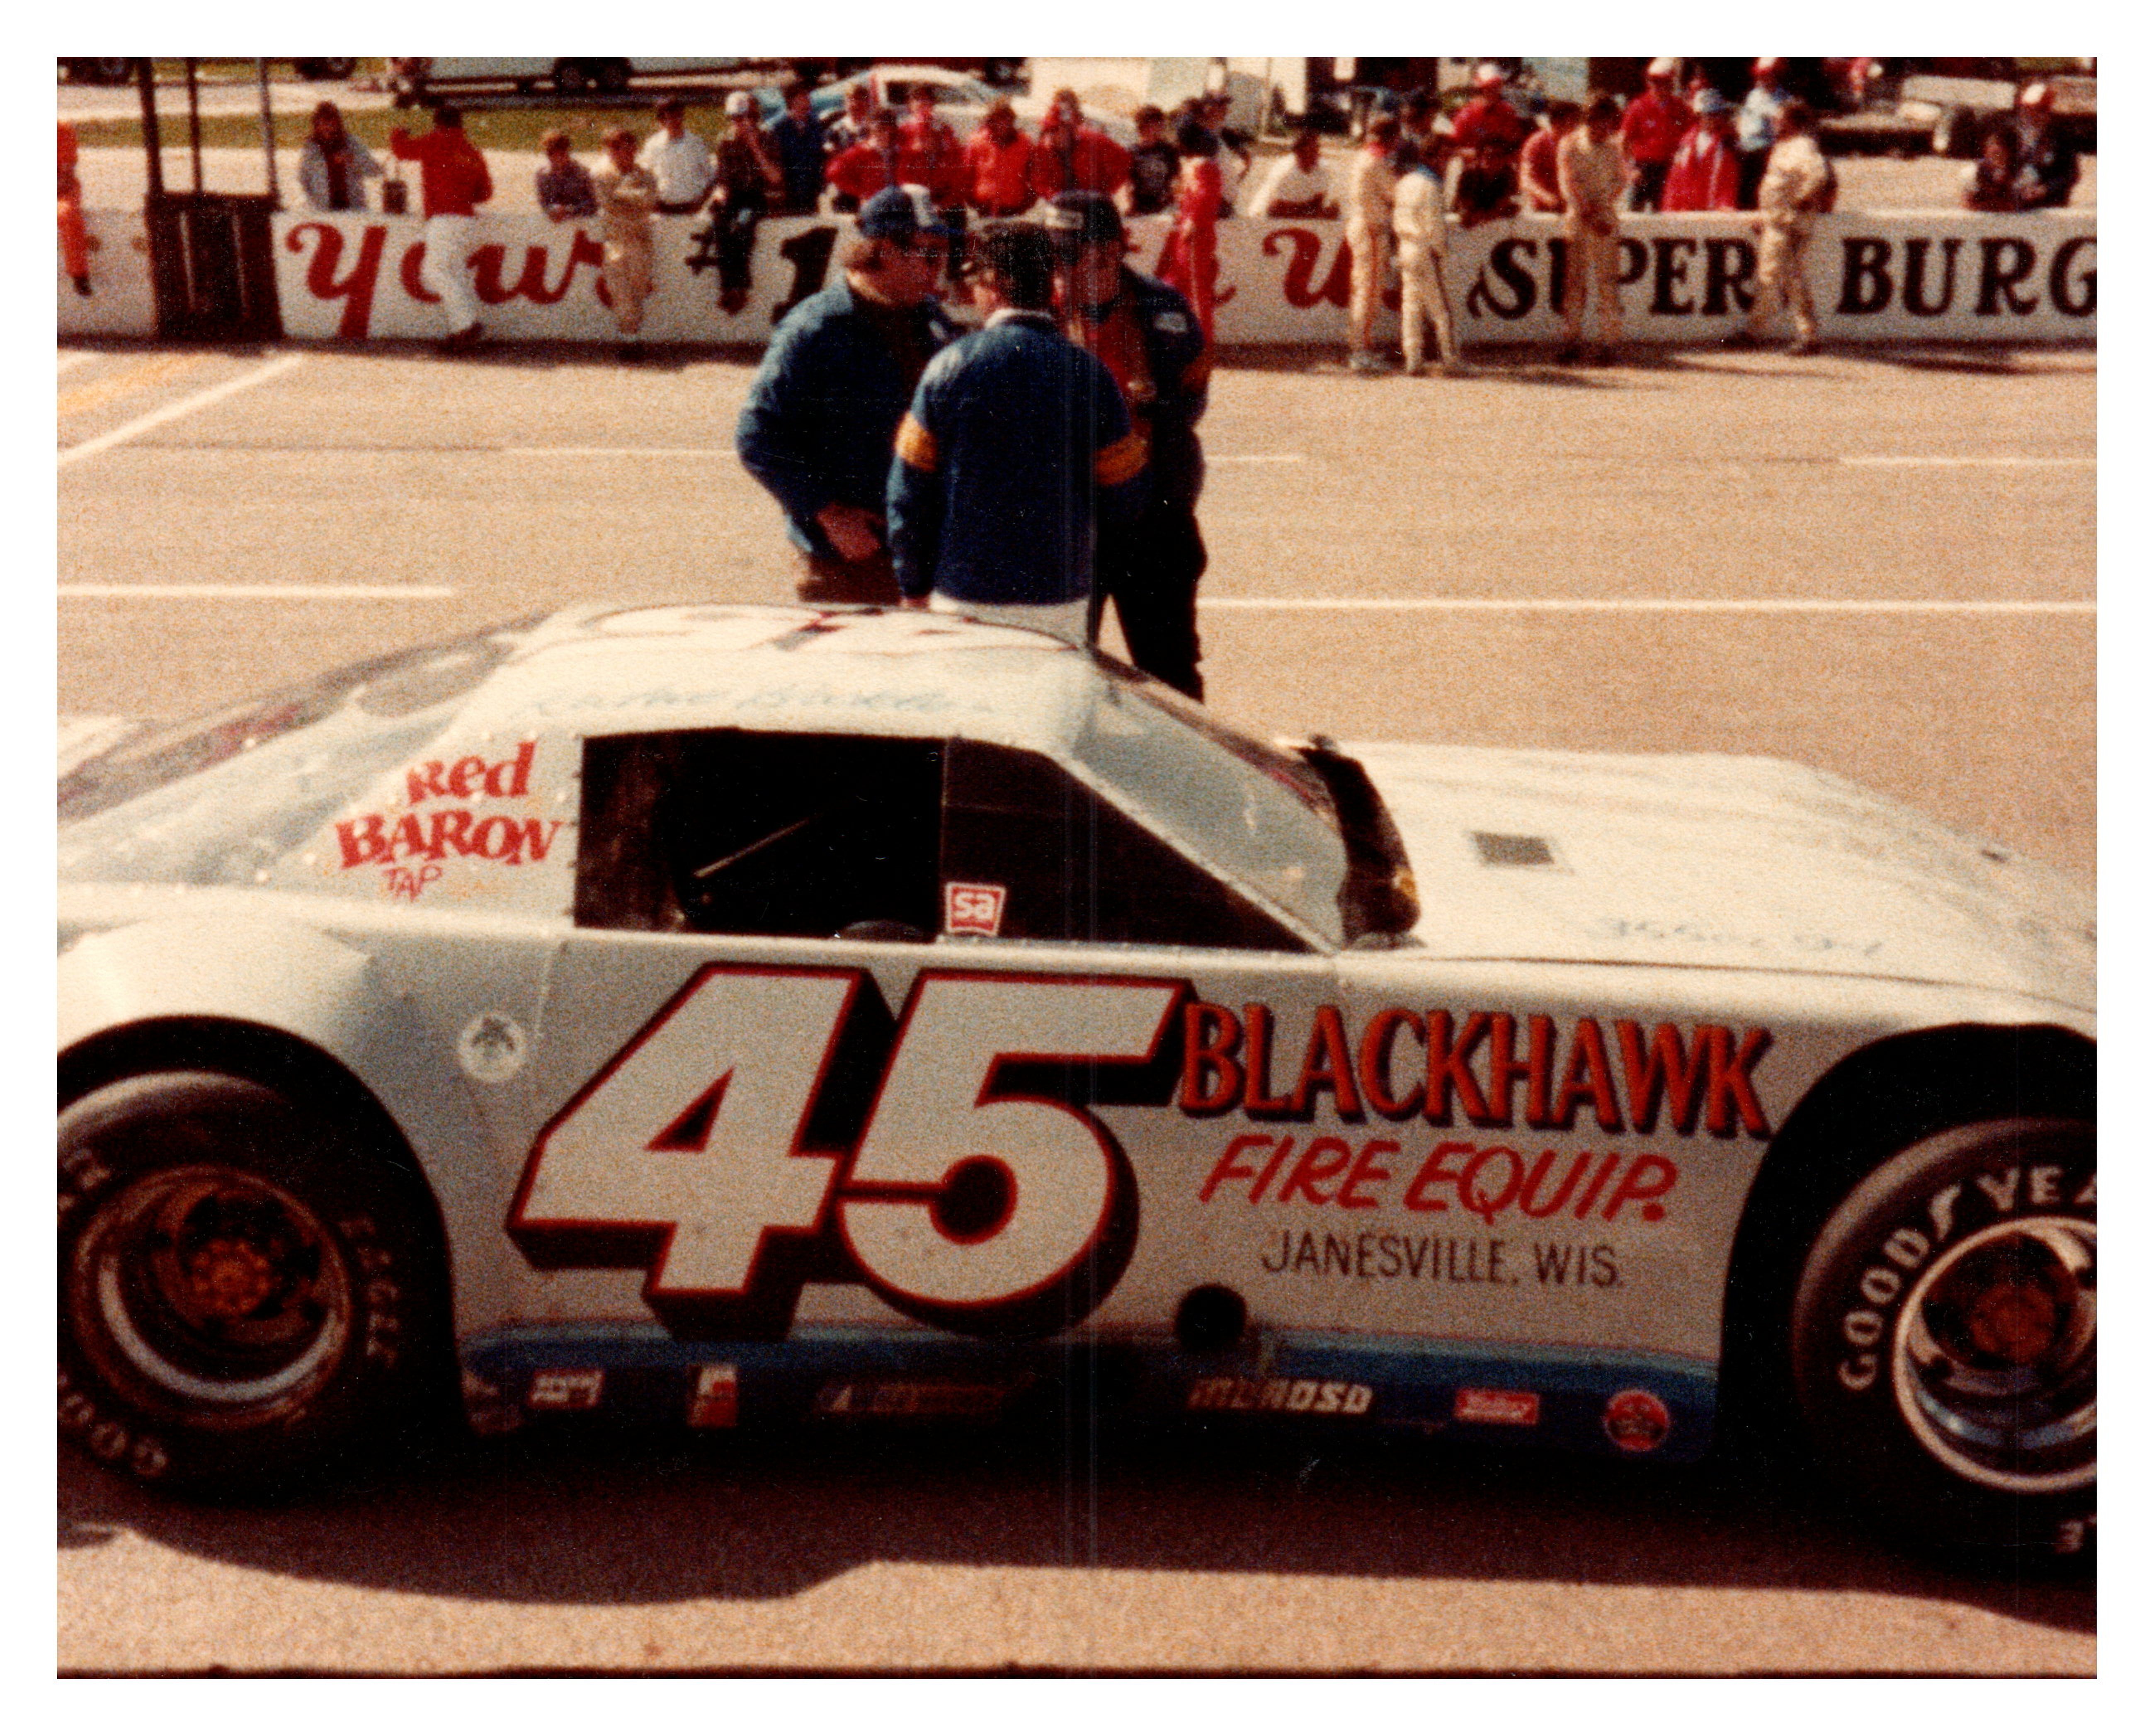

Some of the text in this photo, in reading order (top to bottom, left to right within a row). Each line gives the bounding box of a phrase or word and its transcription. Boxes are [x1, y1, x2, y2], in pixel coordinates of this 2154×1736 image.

[1836, 235, 2097, 318] BURG
[335, 809, 563, 869] BARON
[1179, 1000, 1775, 1141] BLACKHAWK
[506, 960, 1194, 1335] 45
[1199, 1134, 1678, 1226] FIRE EQUIP.
[1533, 1243, 1624, 1289] WIS.
